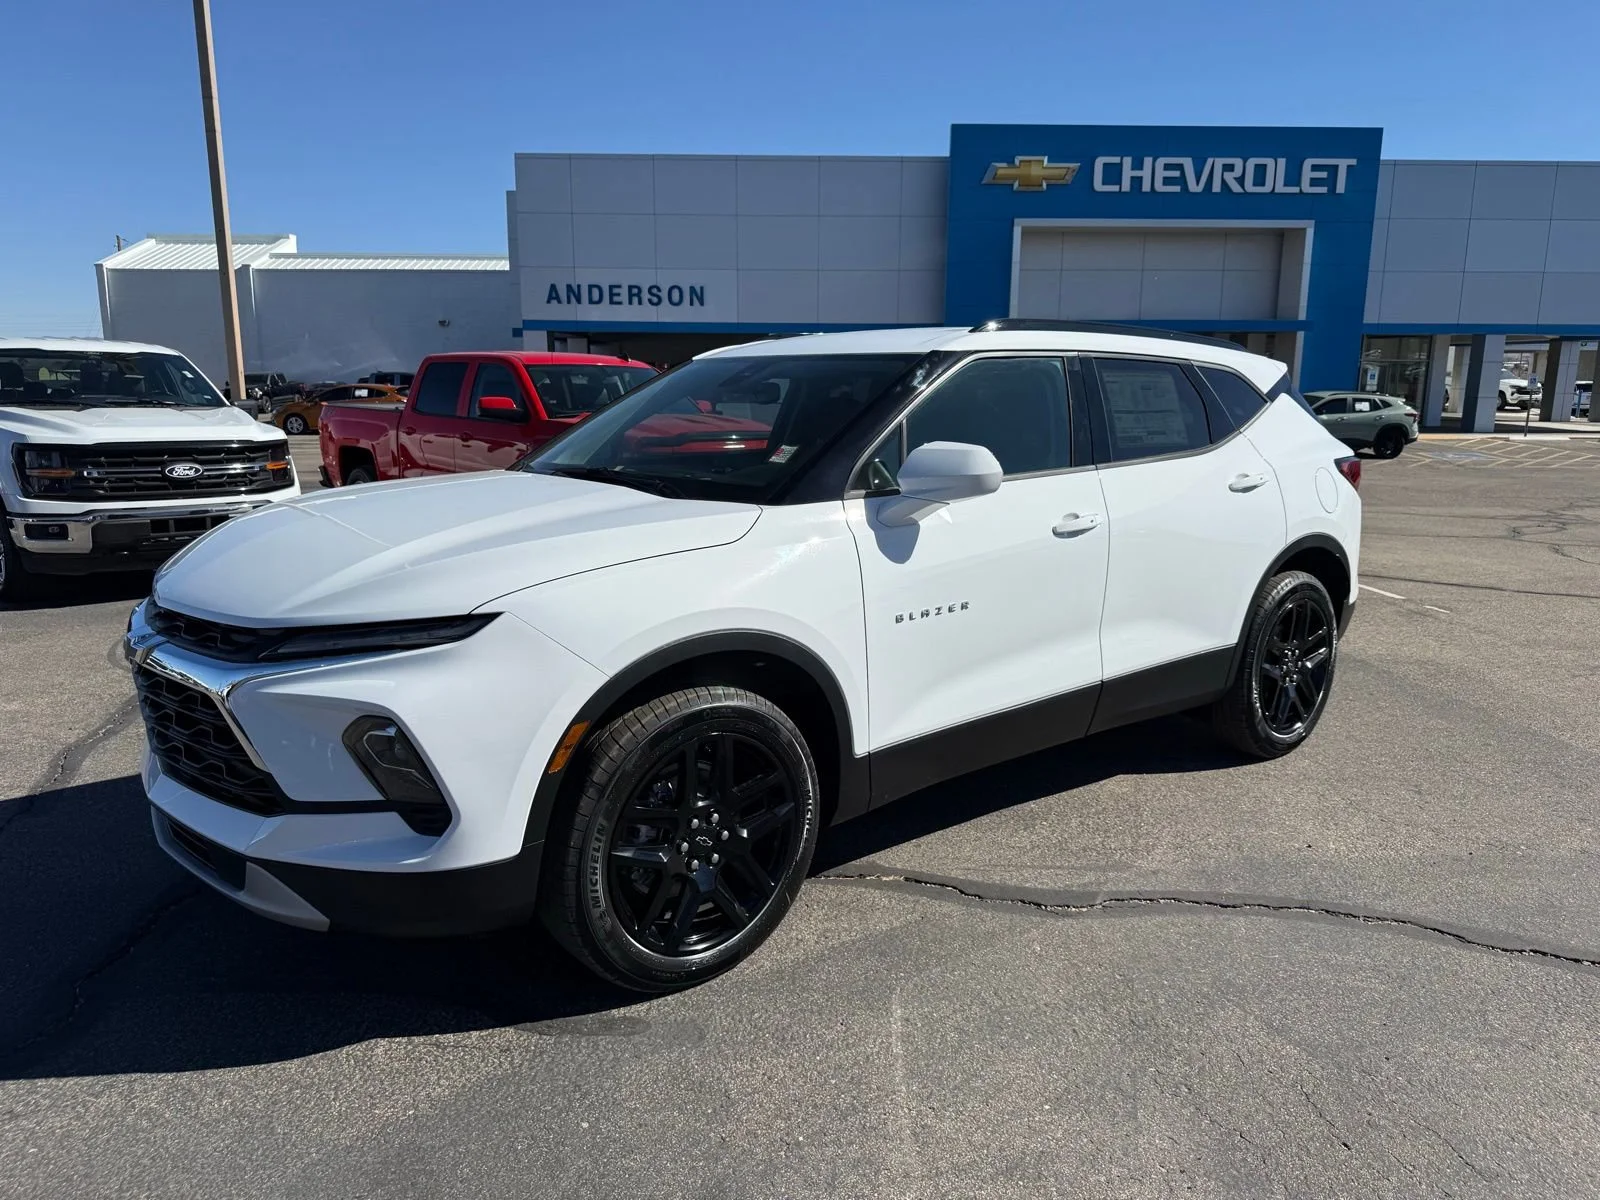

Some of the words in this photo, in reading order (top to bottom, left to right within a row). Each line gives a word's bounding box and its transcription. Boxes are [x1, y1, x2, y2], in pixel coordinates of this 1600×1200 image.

[1093, 156, 1357, 194] CHEVROLET
[546, 283, 705, 307] ANDERSON
[895, 601, 970, 624] BLAZER
[589, 823, 606, 909] MICHELIN
